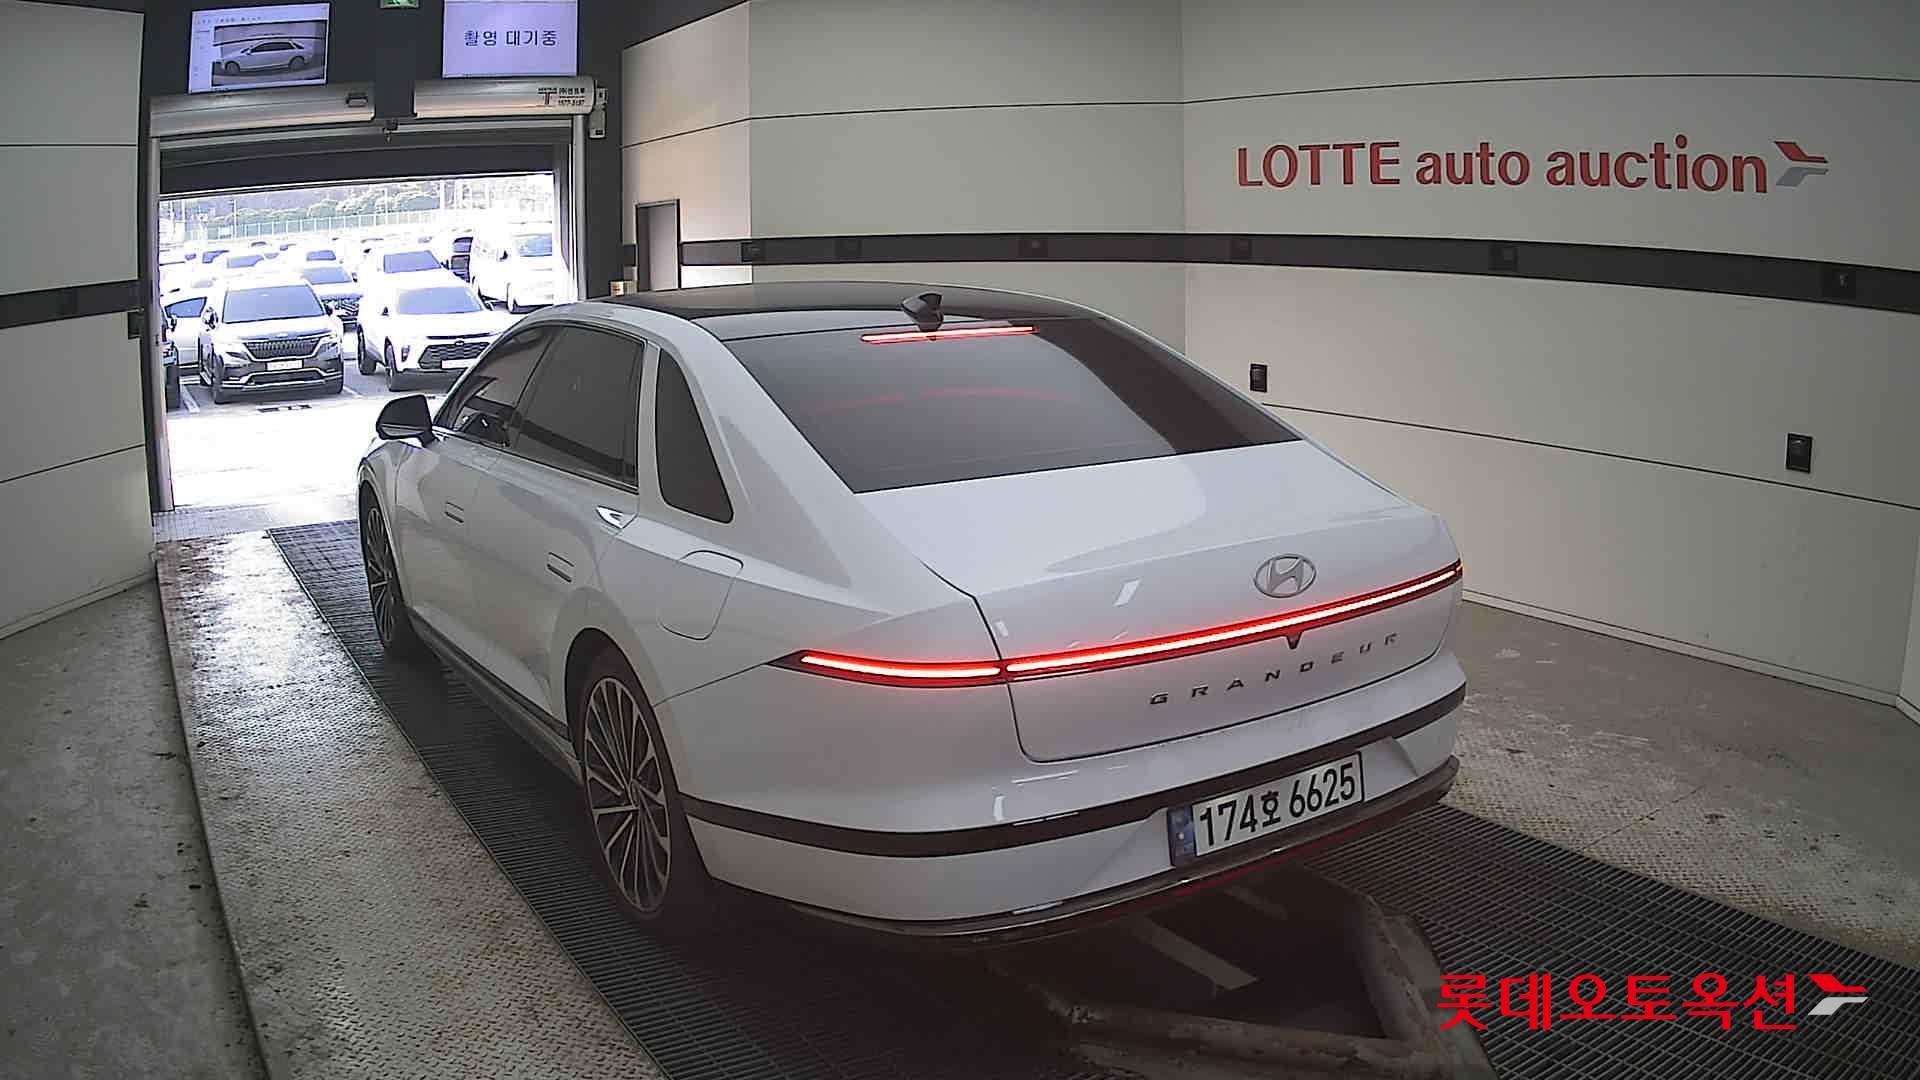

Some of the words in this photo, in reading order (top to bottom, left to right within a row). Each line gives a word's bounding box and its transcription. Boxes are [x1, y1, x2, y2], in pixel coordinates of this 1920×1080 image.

[463, 30, 497, 47] 촬영
[505, 30, 556, 47] 대기중
[1237, 141, 1400, 187] LOTTE
[1415, 142, 1530, 186] auto
[1546, 134, 1768, 194] auction
[1149, 632, 1398, 705] GRANDEUR
[1199, 790, 1281, 848] 174호
[1289, 762, 1356, 819] 6625
